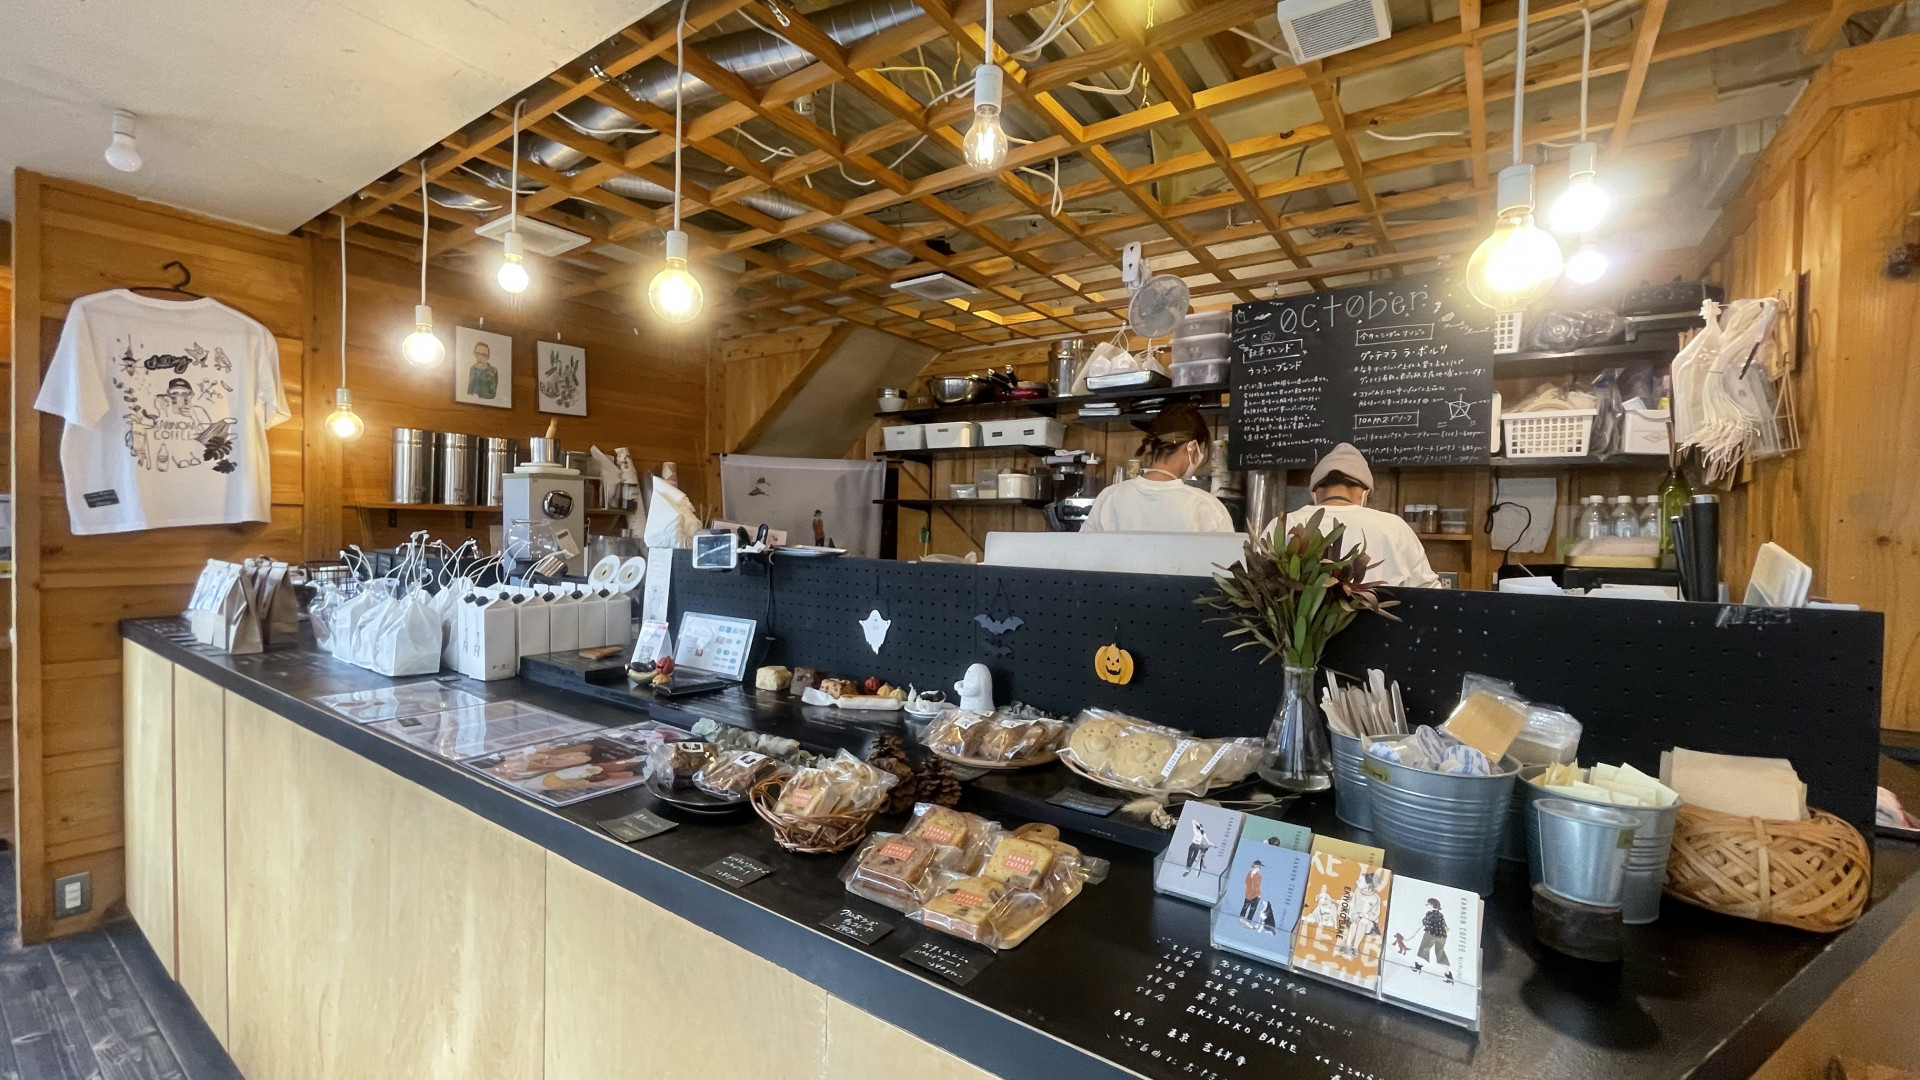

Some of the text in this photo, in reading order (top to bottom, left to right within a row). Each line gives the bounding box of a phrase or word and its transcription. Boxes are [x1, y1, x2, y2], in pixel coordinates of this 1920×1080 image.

[1290, 857, 1301, 882] KANNON
[1284, 883, 1296, 905] COFFEE
[1335, 885, 1352, 940] EKIYOKO BAKE
[1460, 897, 1468, 924] KANNON
[1457, 928, 1467, 953] COFFEE
[1258, 1032, 1298, 1054] BAKE
